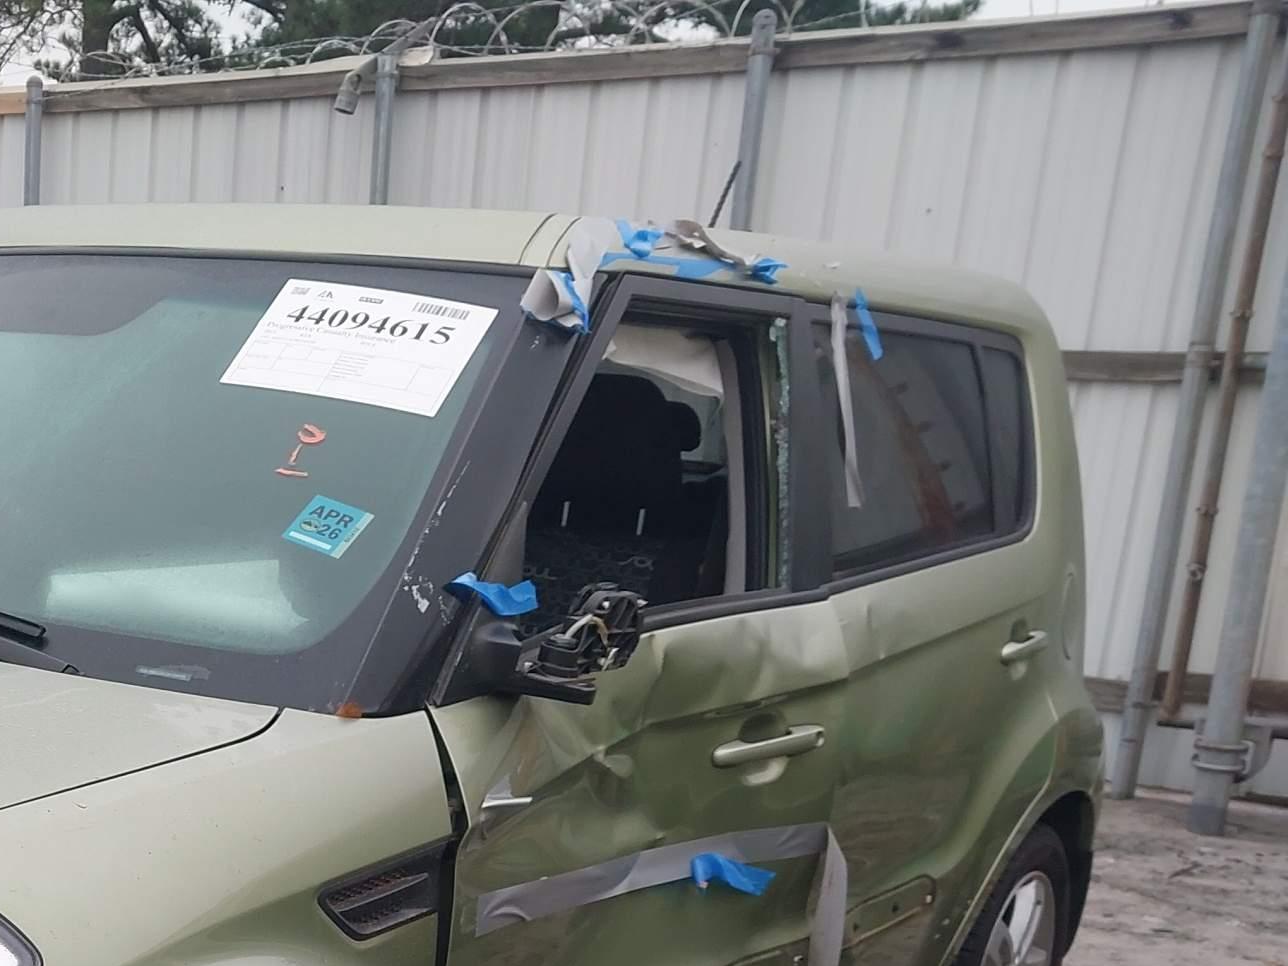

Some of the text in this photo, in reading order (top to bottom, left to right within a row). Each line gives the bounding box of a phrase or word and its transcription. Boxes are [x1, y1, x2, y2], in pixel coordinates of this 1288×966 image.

[286, 304, 456, 345] 44094615
[309, 505, 354, 528] APR
[317, 524, 343, 540] 26
